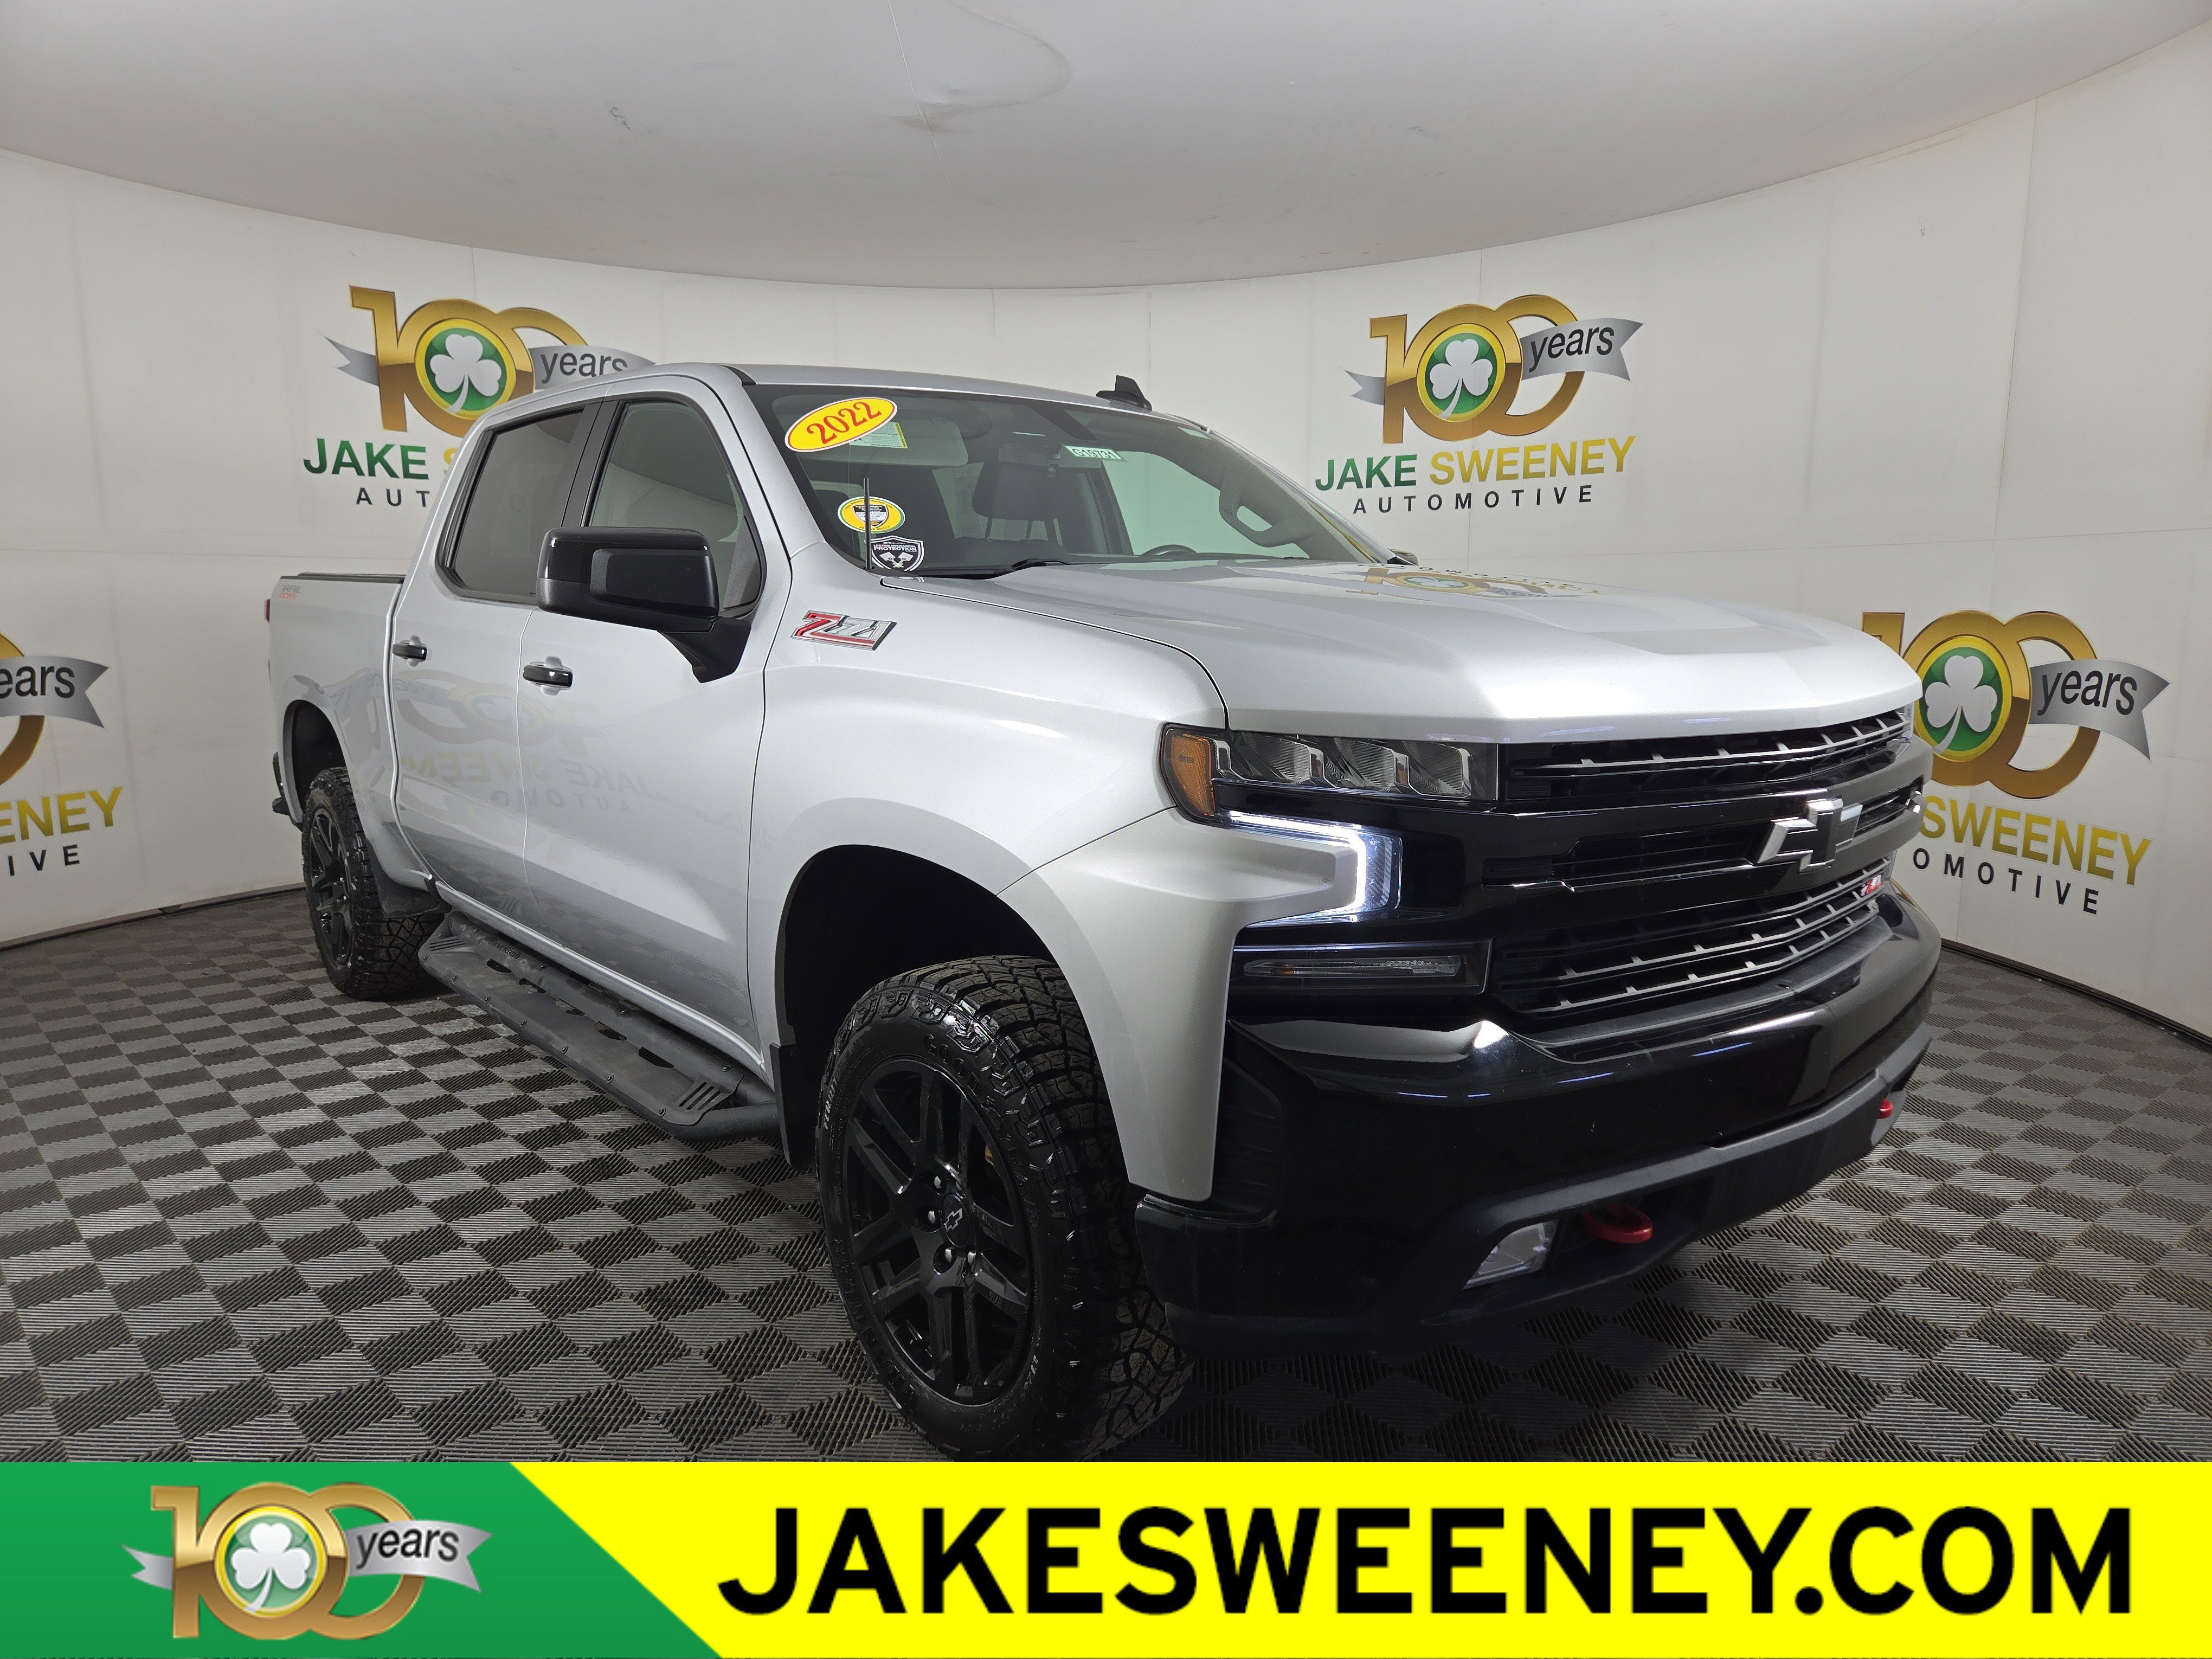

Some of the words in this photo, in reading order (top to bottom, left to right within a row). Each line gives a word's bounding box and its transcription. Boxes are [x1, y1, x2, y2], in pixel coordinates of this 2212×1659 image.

[540, 352, 628, 383] years
[1528, 326, 1615, 373] years
[806, 401, 882, 445] 2022
[303, 438, 429, 480] JAKE
[1071, 448, 1118, 459] G19731
[1315, 454, 1418, 491] JAKE
[1430, 435, 1636, 485] SWEENEY
[1352, 485, 1593, 515] AUTOMOTIVE
[0, 665, 75, 699] ears
[2036, 668, 2138, 716] years
[1920, 795, 2152, 886] SWEENEY
[1913, 847, 2100, 915] OMOTIVE
